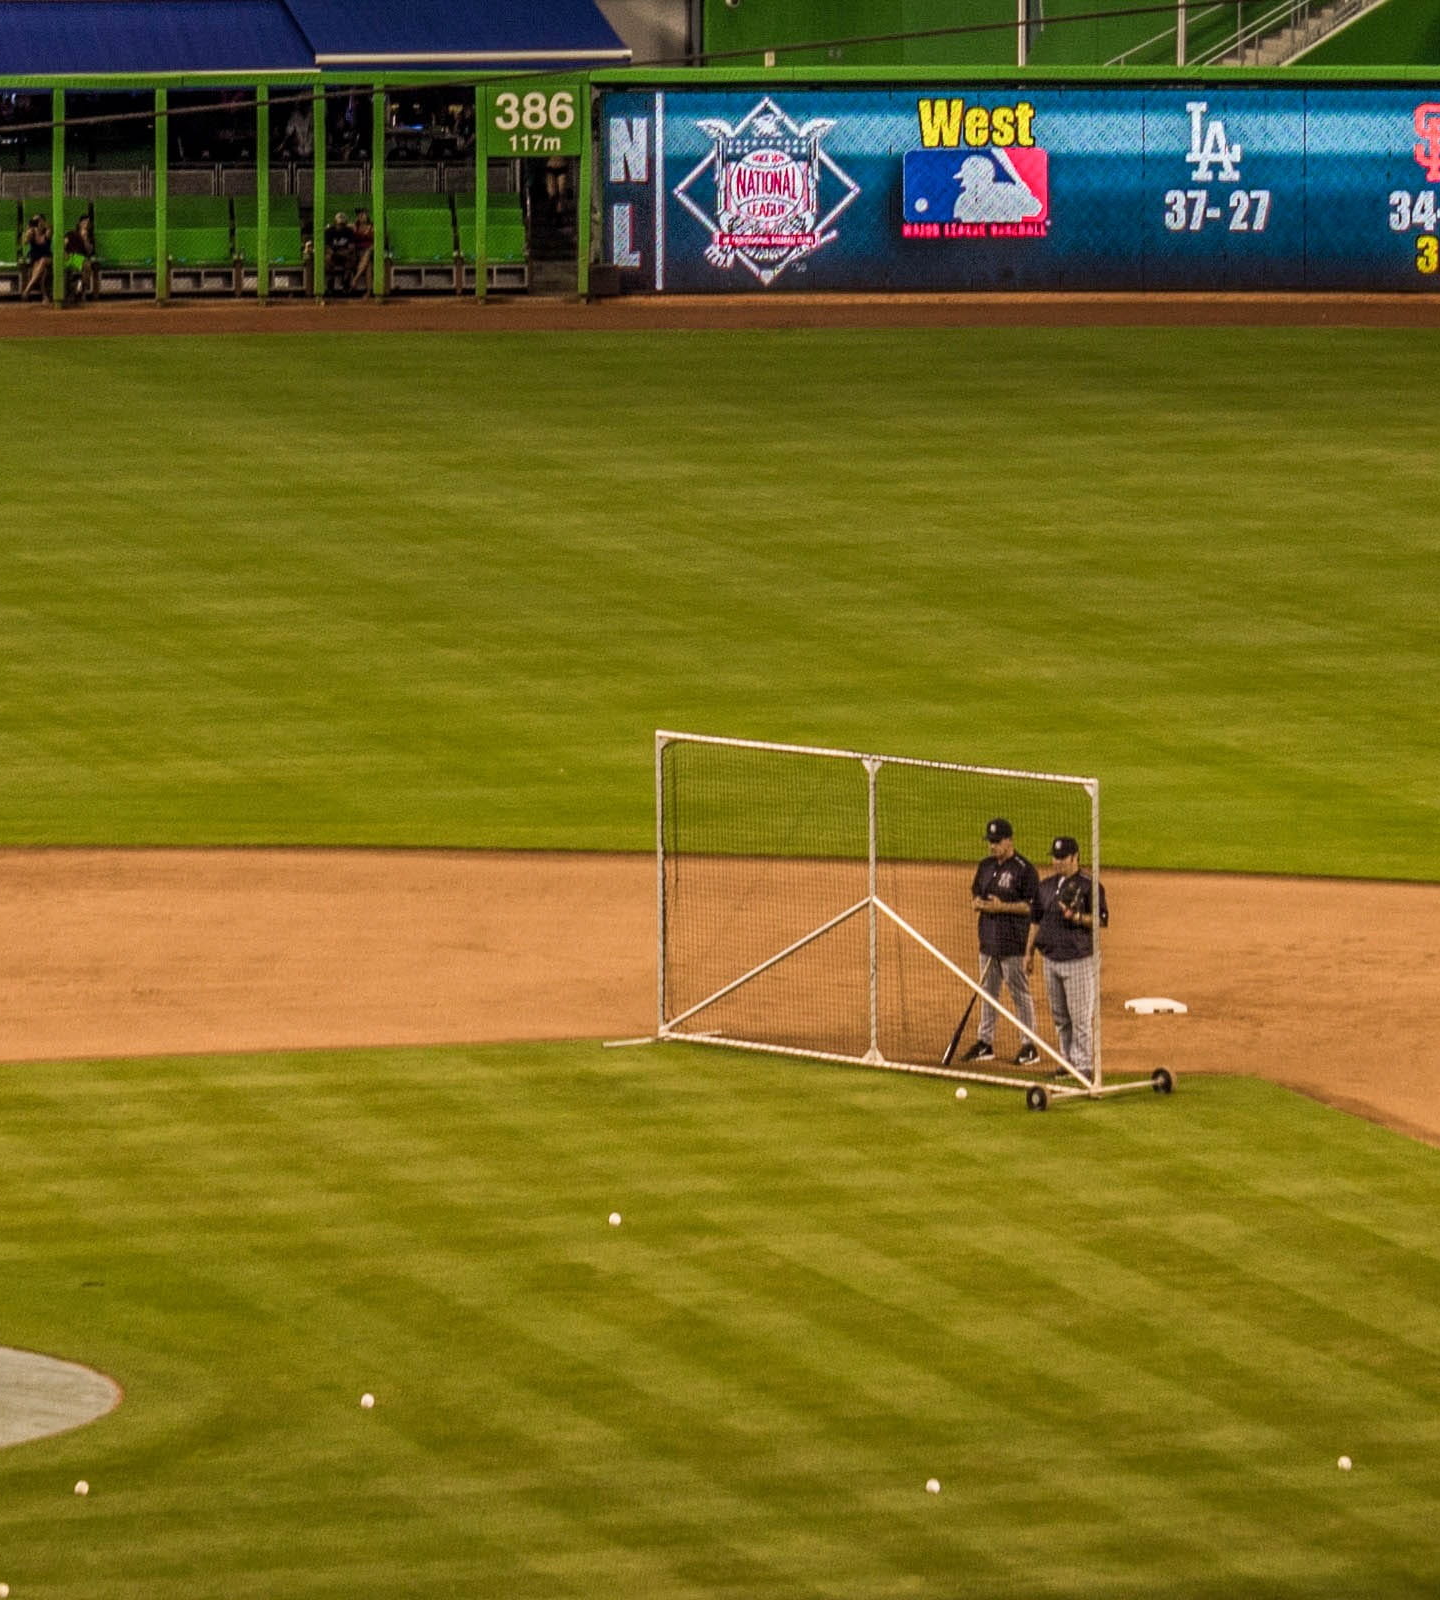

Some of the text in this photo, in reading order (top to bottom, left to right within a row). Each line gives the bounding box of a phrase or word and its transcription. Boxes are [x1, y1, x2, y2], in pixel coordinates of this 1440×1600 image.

[495, 93, 574, 130] 386
[918, 98, 1035, 148] West
[508, 135, 561, 152] 117m
[736, 166, 797, 201] NATIONAL
